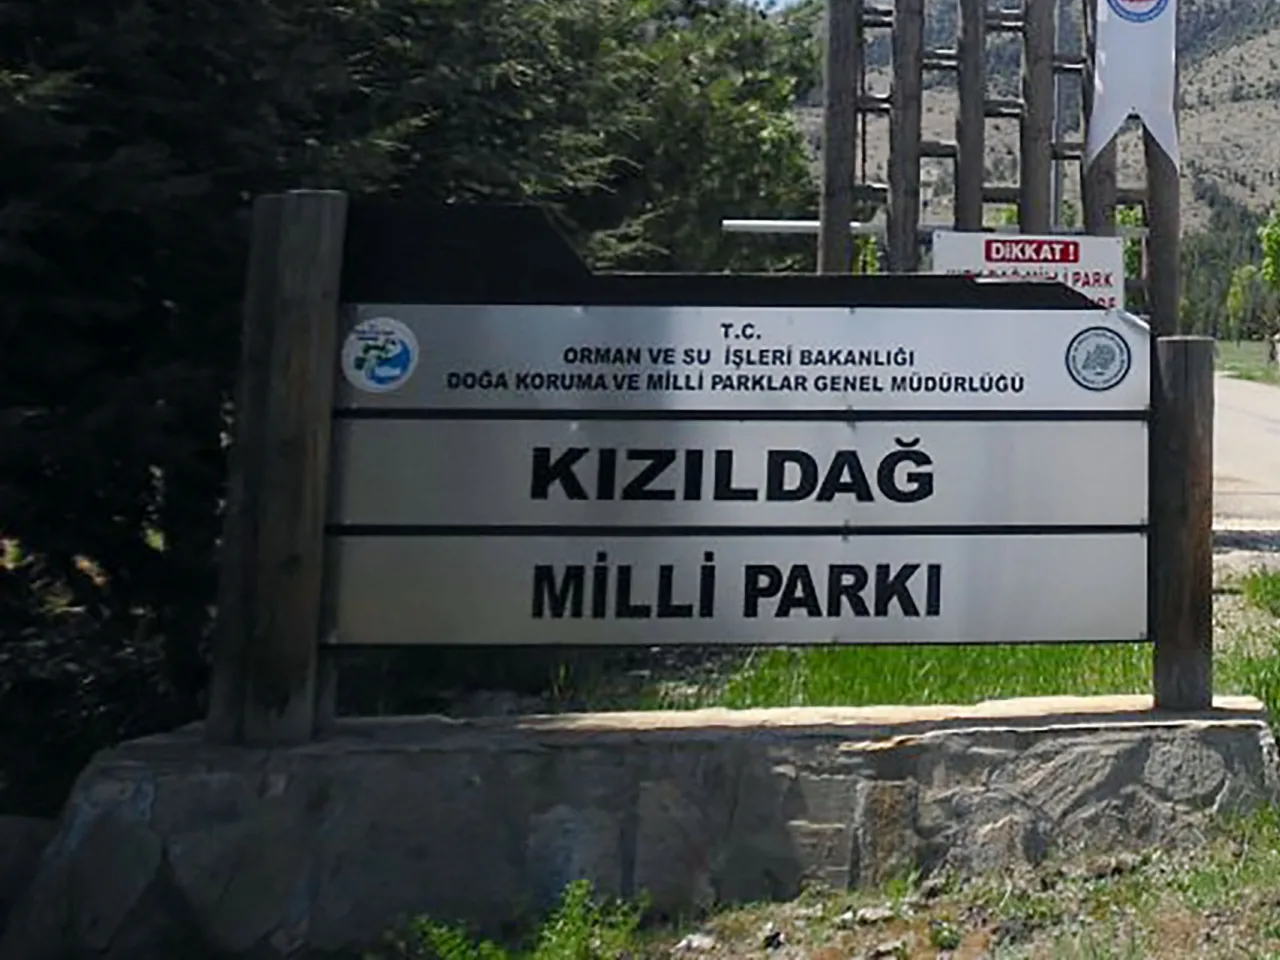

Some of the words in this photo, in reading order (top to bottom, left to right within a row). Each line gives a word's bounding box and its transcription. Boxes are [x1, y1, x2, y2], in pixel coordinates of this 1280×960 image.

[1073, 271, 1113, 288] PARK
[721, 323, 762, 339] T.C.
[563, 346, 641, 365] ORMAN
[647, 347, 676, 365] VE
[682, 347, 712, 366] SU
[724, 344, 793, 371] İŞLERİ
[799, 345, 915, 367] BAKANLIĞI
[447, 369, 508, 390] DOĞA
[515, 372, 609, 391] KORUMA
[612, 373, 641, 391] VE
[646, 370, 704, 391] MİLLİ
[711, 374, 808, 391] PARKLAR
[814, 375, 884, 392] GENEL
[891, 371, 1025, 393] MÜDÜRLÜĞÜ
[530, 436, 934, 503] KIZILDAĞ
[531, 551, 715, 619] MİLLİ
[743, 563, 941, 618] PARKI
